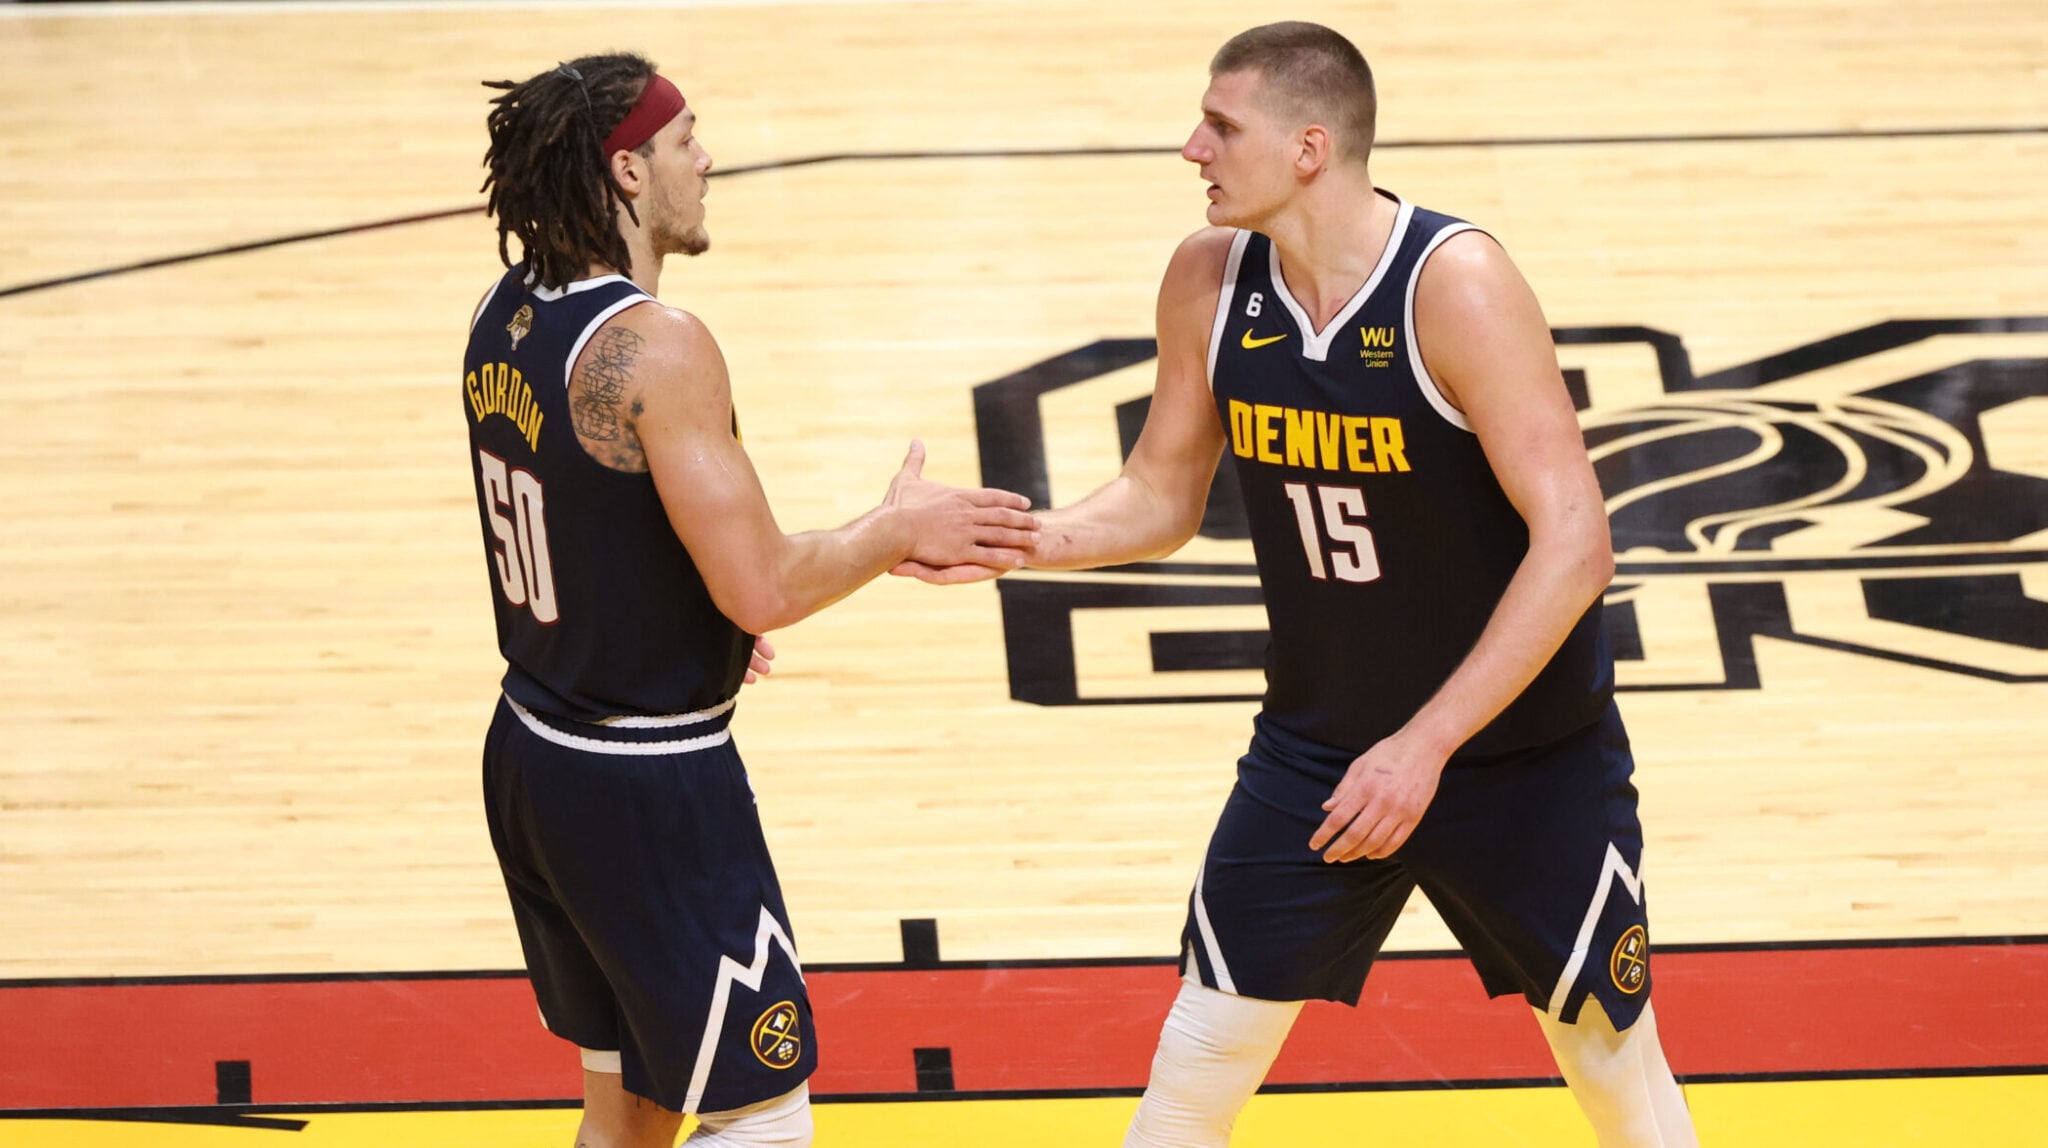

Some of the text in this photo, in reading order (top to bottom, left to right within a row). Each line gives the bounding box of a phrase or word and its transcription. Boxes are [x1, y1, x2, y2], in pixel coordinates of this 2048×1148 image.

[1245, 292, 1264, 318] 6
[1360, 327, 1395, 347] WU
[1360, 350, 1394, 359] Western
[1365, 359, 1389, 368] Union
[465, 362, 545, 453] GORDON
[1229, 399, 1412, 473] DENVER
[479, 448, 561, 624] 50
[1283, 480, 1383, 584] 15
